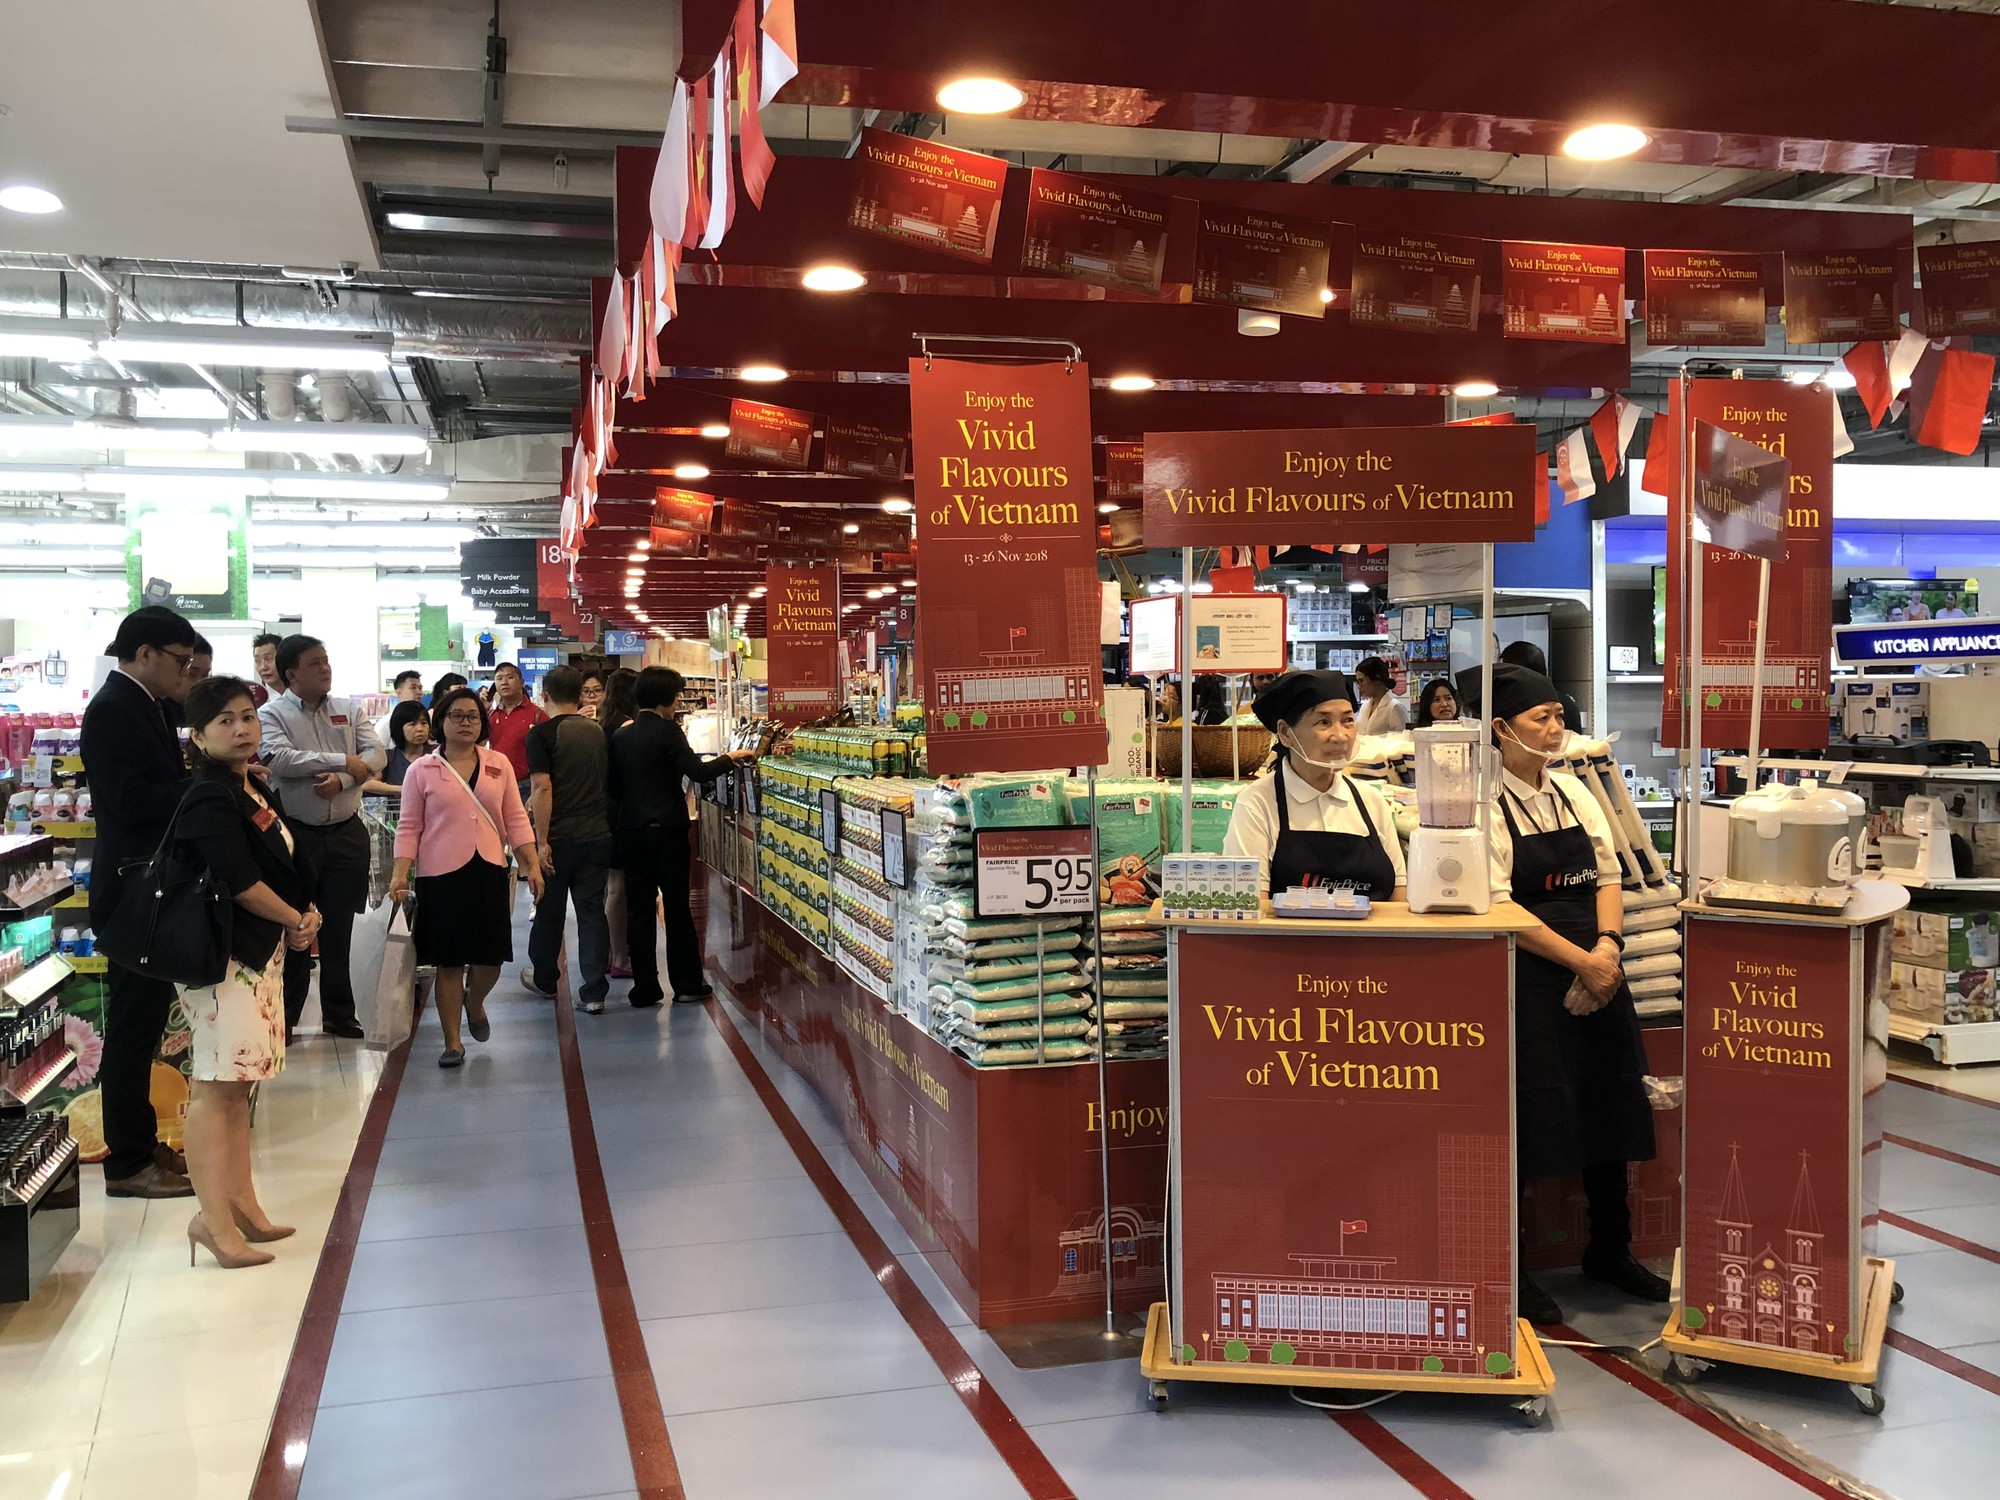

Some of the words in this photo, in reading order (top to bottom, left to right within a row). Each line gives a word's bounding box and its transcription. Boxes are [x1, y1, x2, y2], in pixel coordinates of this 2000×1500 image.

[914, 147, 939, 163] Enjoy
[940, 154, 954, 166] the
[867, 146, 895, 164] Vivid
[898, 154, 943, 176] Flavours
[953, 168, 997, 190] Vietnam
[1083, 185, 1107, 199] Enjoy
[1108, 191, 1122, 201] the
[1038, 187, 1065, 203] Vivid
[1068, 193, 1111, 212] Flavours
[1121, 204, 1163, 222] Vietnam
[1247, 216, 1269, 228] Enjoy
[1271, 220, 1285, 230] the
[1205, 220, 1229, 234] Vivid
[1233, 224, 1275, 240] Flavours
[1284, 232, 1324, 248] Vietnam
[1401, 237, 1422, 248] Enjoy
[1425, 240, 1438, 249] the
[1361, 243, 1385, 256] Vivid
[1388, 246, 1428, 260] Flavours
[1436, 252, 1475, 266] Vietnam
[1547, 250, 1568, 261] Enjoy
[1570, 252, 1582, 261] the
[1688, 257, 1707, 268] Enjoy
[1710, 258, 1721, 266] the
[1825, 256, 1845, 265] Enjoy
[1847, 256, 1857, 264] the
[1509, 258, 1532, 270] Vivid
[1535, 259, 1574, 272] Flavours
[1582, 262, 1619, 275] Vietnam
[1651, 266, 1674, 277] Vivid
[1676, 267, 1714, 278] Flavours
[1721, 268, 1757, 279] Vietnam
[1791, 266, 1813, 276] Vivid
[1815, 266, 1851, 276] Flavours
[1857, 264, 1892, 275] Vietnam
[965, 391, 1007, 412] Enjoy
[1011, 392, 1034, 408] the
[1722, 406, 1763, 425] Enjoy
[1766, 407, 1788, 422] the
[956, 419, 1036, 450] Vivid
[939, 457, 1068, 488] Flavours
[1284, 451, 1350, 478] Enjoy
[1356, 450, 1392, 472] the
[1733, 457, 1748, 488] Enjoy
[1750, 465, 1759, 487] the
[1164, 488, 1236, 514] Vivid
[1245, 486, 1366, 513] Flavours
[1373, 493, 1393, 511] of
[1394, 484, 1515, 511] Vietnam
[1701, 480, 1722, 512] Vivid
[1757, 500, 1784, 533] Vietnam
[930, 504, 952, 525] of
[953, 494, 1079, 525] Vietnam
[542, 545, 561, 564] 18
[964, 553, 973, 566] 13
[982, 552, 995, 563] 26
[998, 550, 1021, 562] Nov
[1025, 550, 1048, 562] 2018
[1711, 552, 1720, 563] 13
[1728, 550, 1741, 561] 26
[789, 577, 808, 586] Enjoy
[809, 577, 820, 585] the
[471, 588, 488, 596] Baby
[489, 587, 530, 595] Accessories
[786, 588, 820, 602] Vivid
[580, 613, 593, 623] 22
[777, 603, 833, 617] Flavours
[900, 609, 907, 620] 8
[773, 622, 783, 631] of
[783, 618, 836, 631] Vietnam
[879, 620, 885, 629] 9
[1873, 638, 1929, 654] KITCHEN
[1103, 803, 1130, 811] FairPrice
[1320, 878, 1371, 891] FairPrice
[1564, 868, 1597, 886] FairPric
[1736, 961, 1773, 978] Enjoy
[1776, 964, 1797, 977] the
[1297, 974, 1352, 998] Enjoy
[1357, 976, 1388, 994] the
[1729, 981, 1797, 1009] Vivid
[1201, 1005, 1303, 1042] Vivid
[1316, 1007, 1485, 1047] Flavours
[1712, 1007, 1824, 1039] Flavours
[859, 1008, 878, 1048] Vivid
[879, 1023, 909, 1076] Flavours
[913, 1052, 949, 1113] Vietnam
[1702, 1042, 1721, 1058] of
[1722, 1036, 1832, 1068] Vietnam
[1246, 1061, 1274, 1086] of
[1275, 1050, 1441, 1090] Vietnam
[1085, 1100, 1169, 1138] Enjoy
